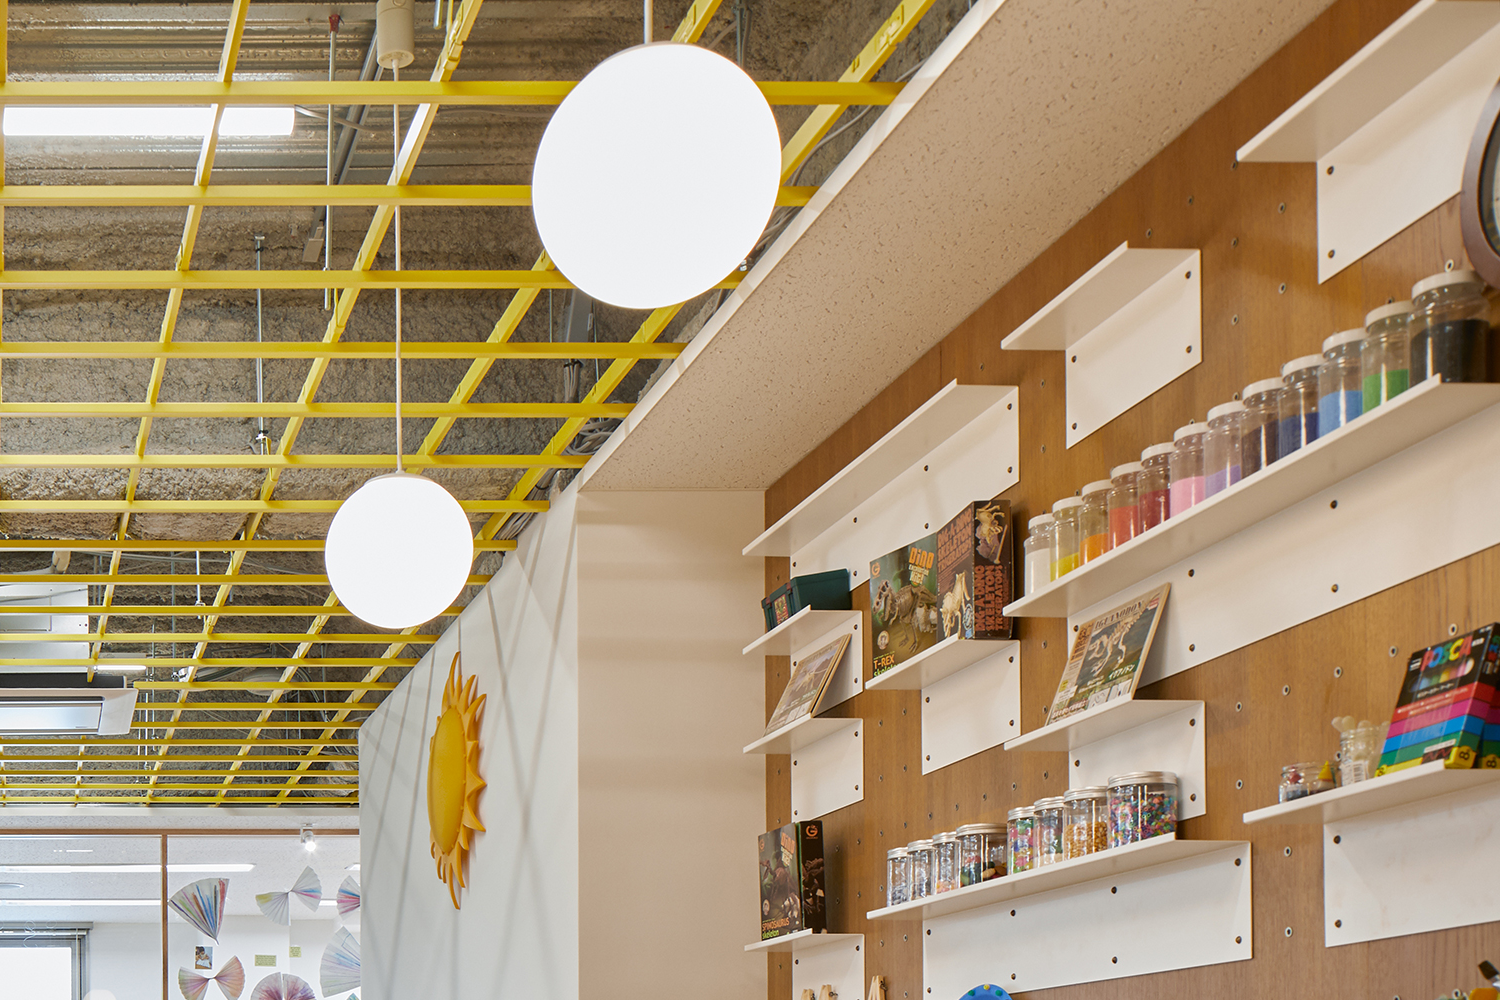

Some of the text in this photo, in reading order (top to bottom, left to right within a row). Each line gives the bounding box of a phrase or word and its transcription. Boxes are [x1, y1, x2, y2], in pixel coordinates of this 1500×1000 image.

[985, 565, 995, 631] SKELETON
[873, 654, 895, 669] T-REX
[1421, 635, 1473, 672] POSCA
[761, 917, 790, 931] SPINOSAURUS
